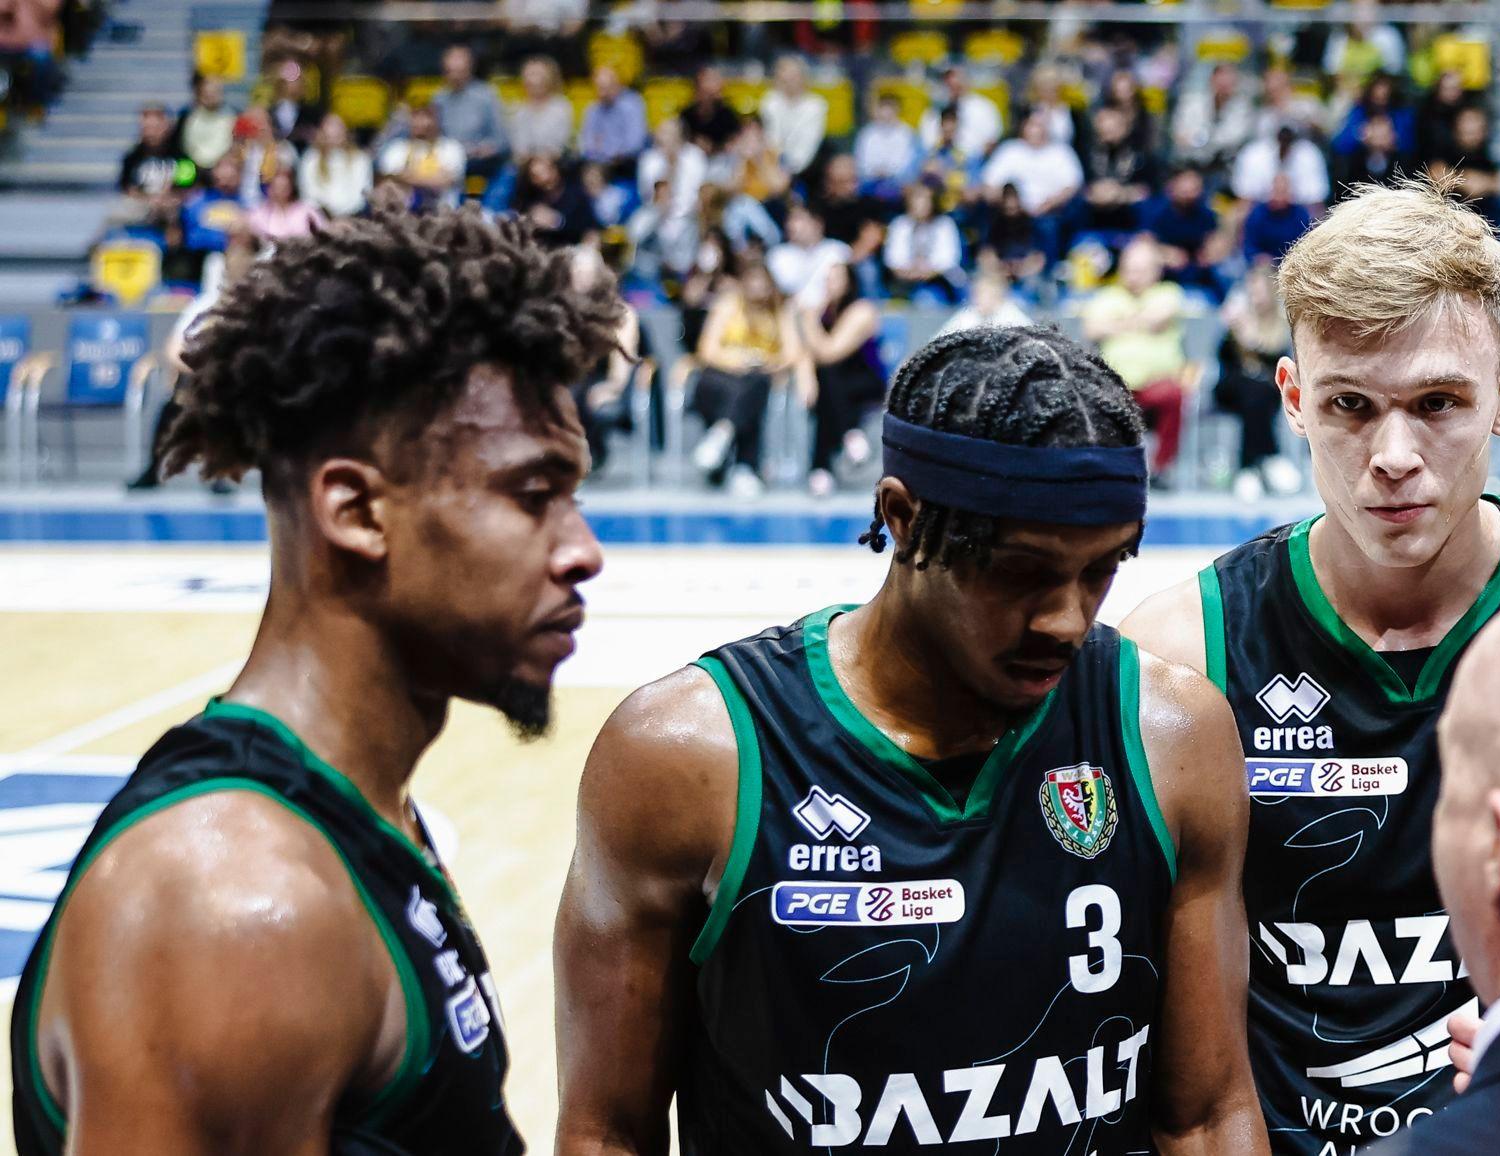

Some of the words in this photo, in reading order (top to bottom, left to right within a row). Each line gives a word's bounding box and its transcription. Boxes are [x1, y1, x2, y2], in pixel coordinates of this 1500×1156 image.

[1251, 768, 1305, 787] PGE
[1352, 764, 1398, 775] Basket
[1351, 778, 1380, 792] Liga
[787, 893, 850, 914] PGE
[902, 887, 952, 901] Basket
[902, 905, 933, 919] Liga
[1065, 884, 1122, 994] 3
[1262, 915, 1470, 985] BAZ
[784, 1024, 1149, 1146] BAZALT
